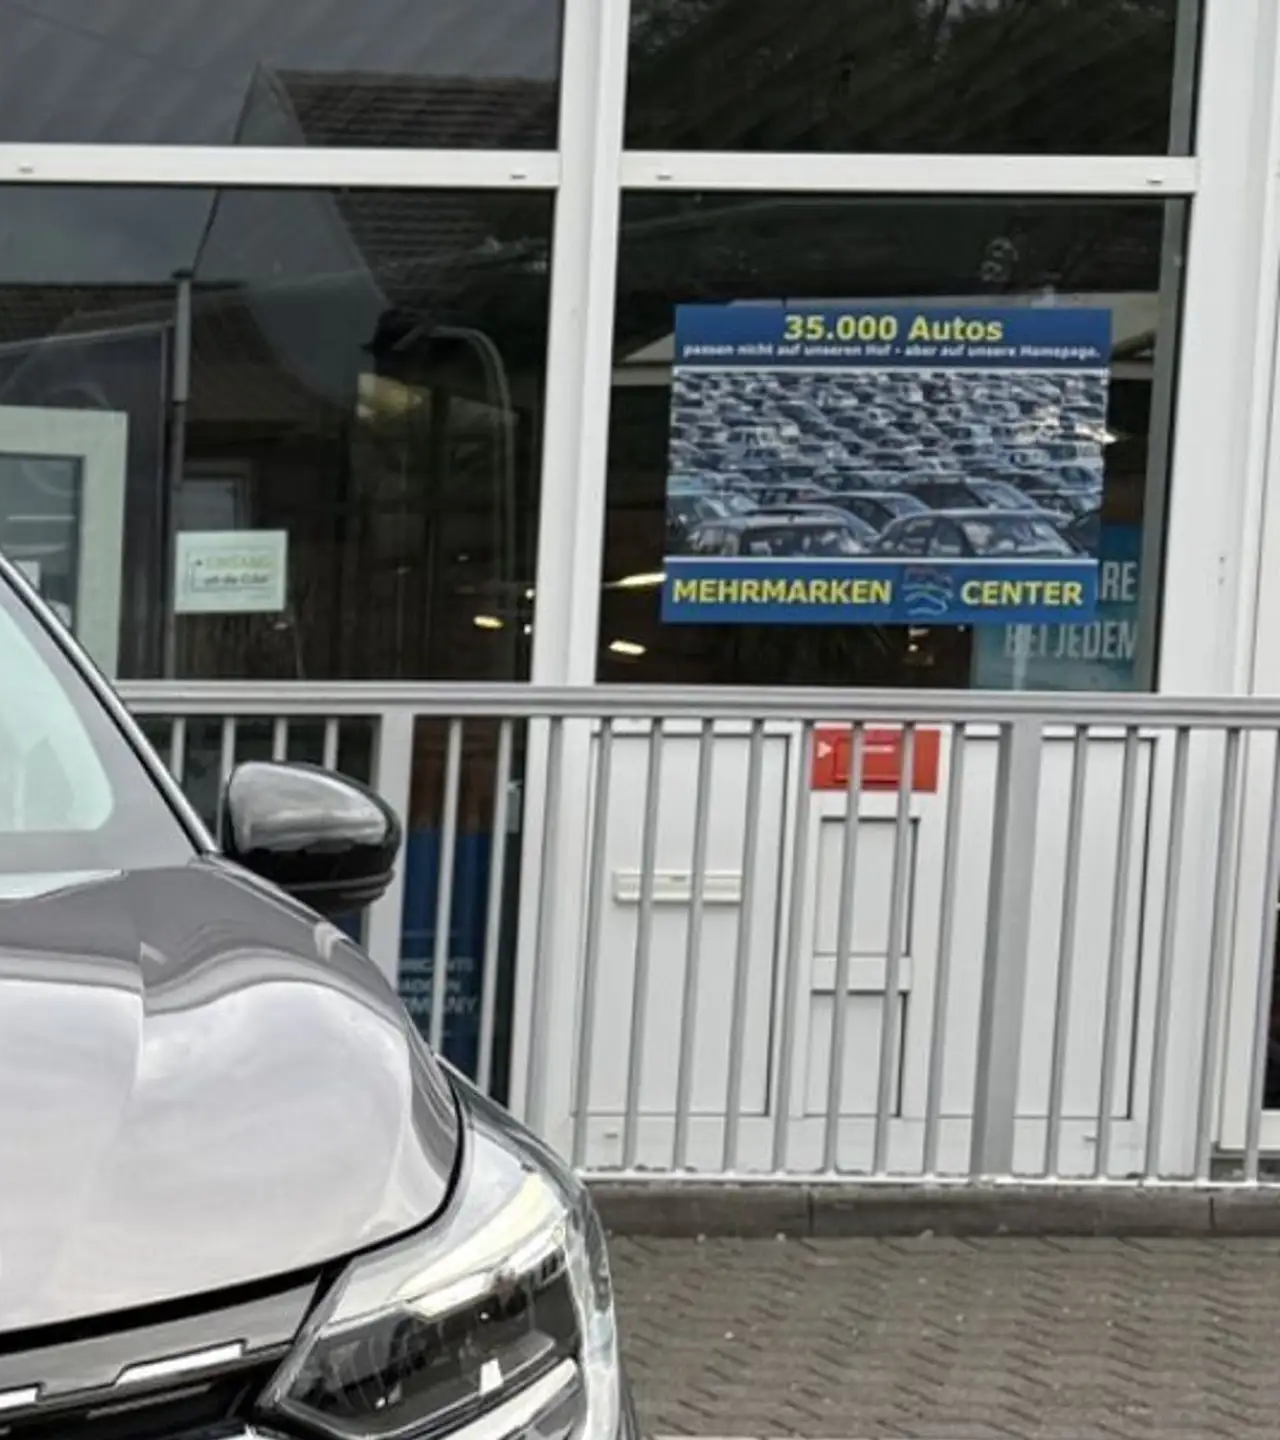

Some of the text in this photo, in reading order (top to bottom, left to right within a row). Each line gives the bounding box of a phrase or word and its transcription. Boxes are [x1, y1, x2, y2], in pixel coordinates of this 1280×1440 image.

[783, 314, 1004, 342] 35.000 Autos
[672, 577, 1085, 607] MEHRMARKEN CENTER
[1053, 620, 1138, 661] JEDEN
